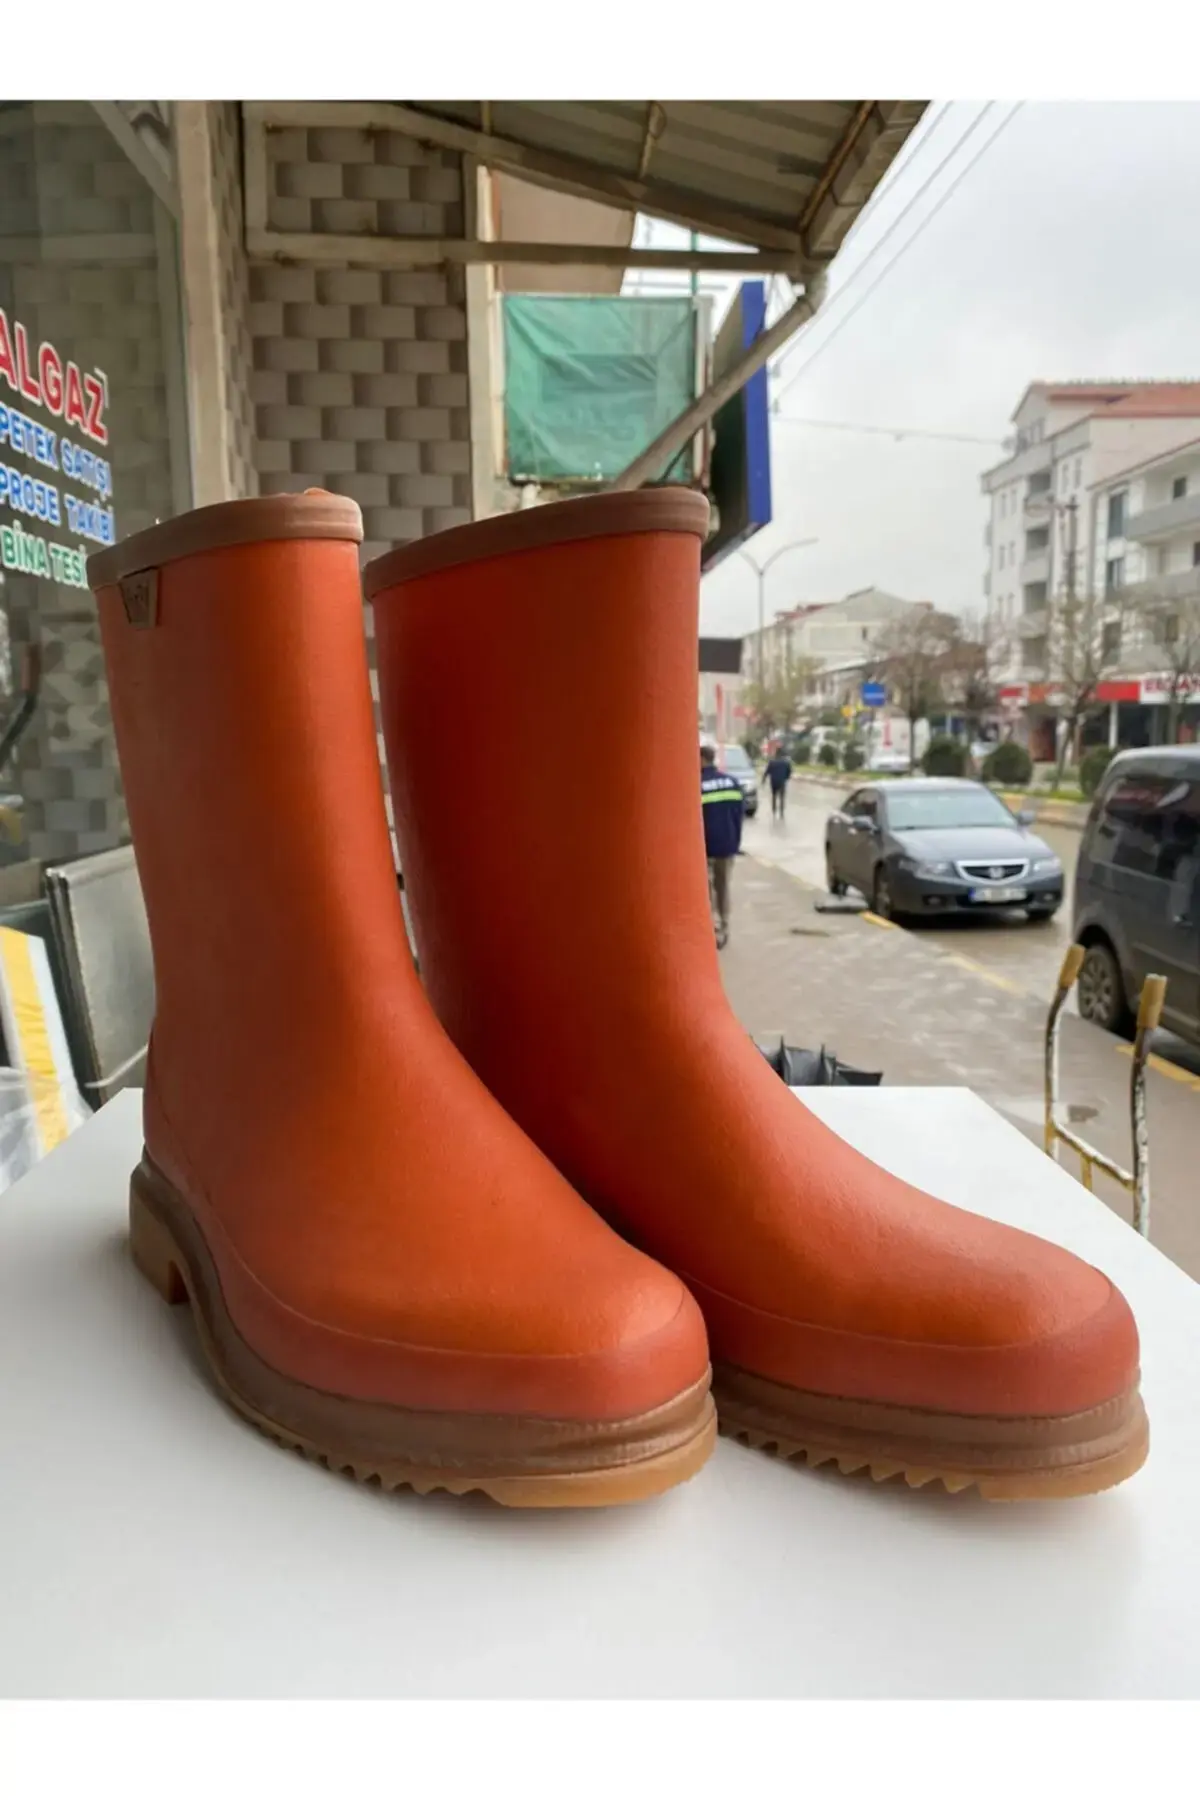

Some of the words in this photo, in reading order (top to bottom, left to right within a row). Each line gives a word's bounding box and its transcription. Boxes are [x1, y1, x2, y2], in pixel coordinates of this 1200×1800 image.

[0, 402, 59, 471] PETEK
[0, 462, 61, 526] PROJE
[0, 519, 51, 579] BİNA
